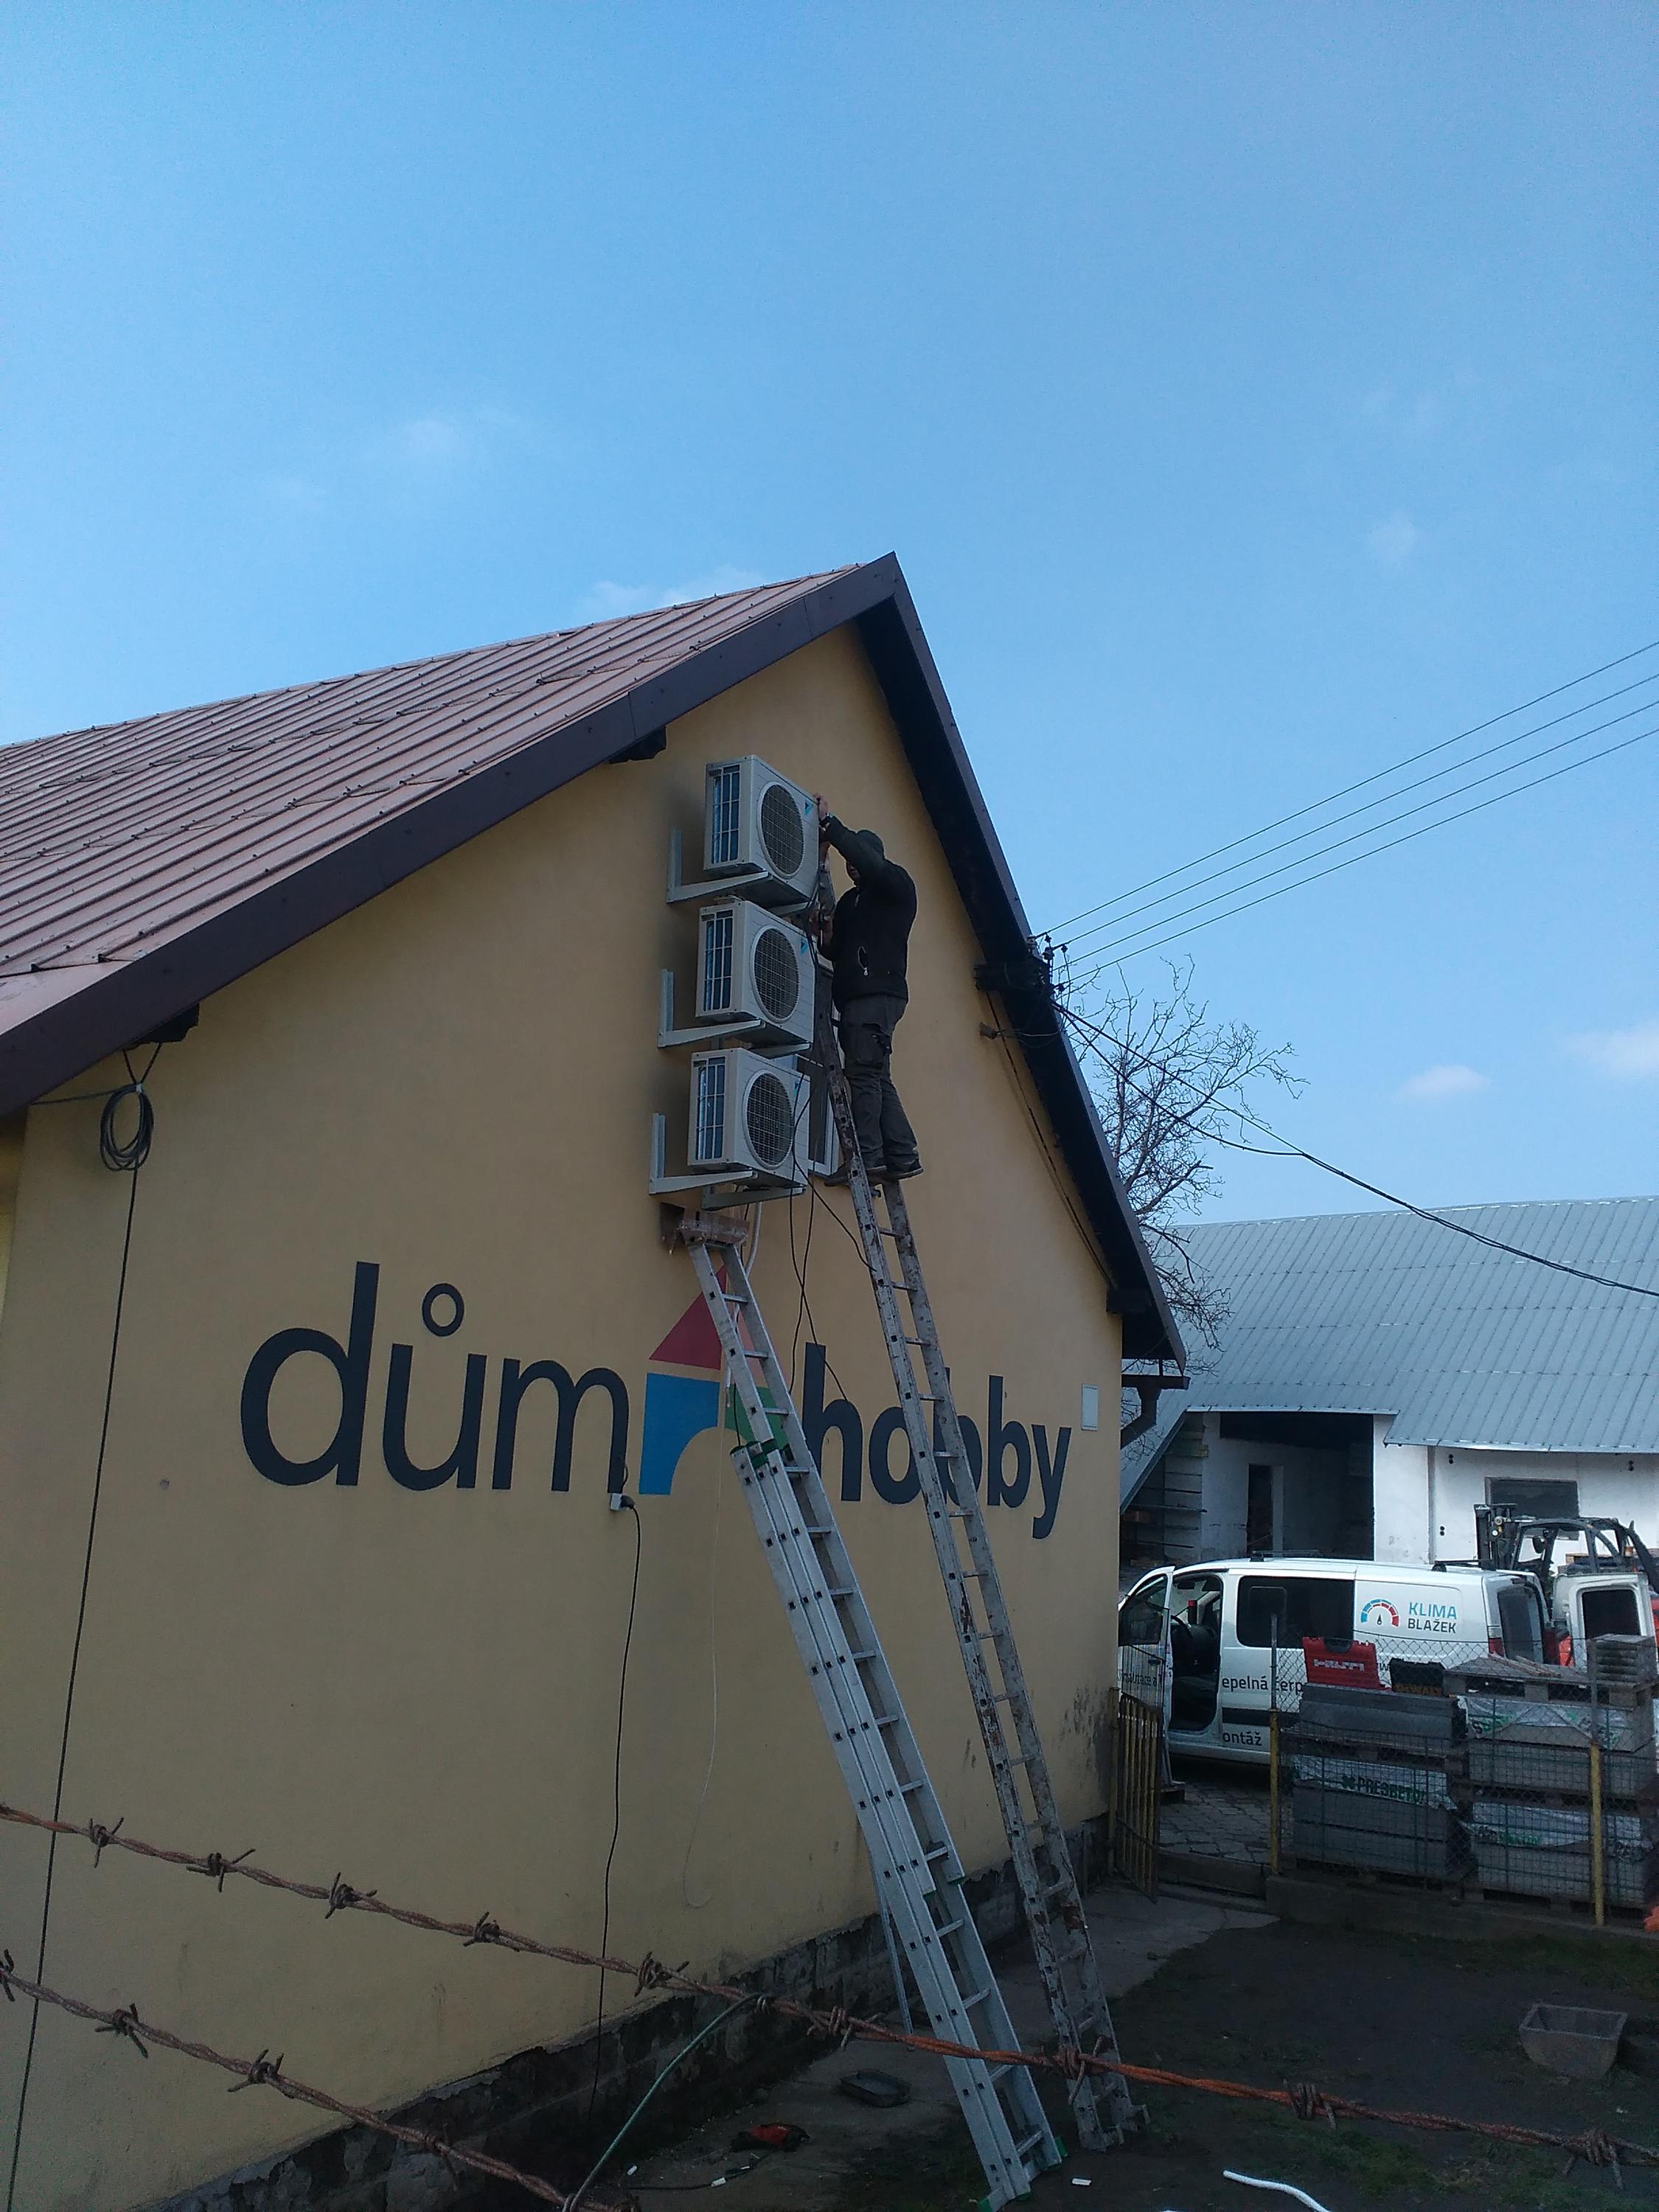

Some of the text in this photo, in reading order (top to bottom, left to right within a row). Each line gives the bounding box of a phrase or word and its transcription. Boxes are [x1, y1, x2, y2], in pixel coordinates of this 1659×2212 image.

[240, 1262, 1071, 1540] dům hobby
[1409, 1601, 1457, 1619] KLIMA
[1408, 1618, 1456, 1634] BLAŽEK
[1313, 1658, 1365, 1671] HILTI
